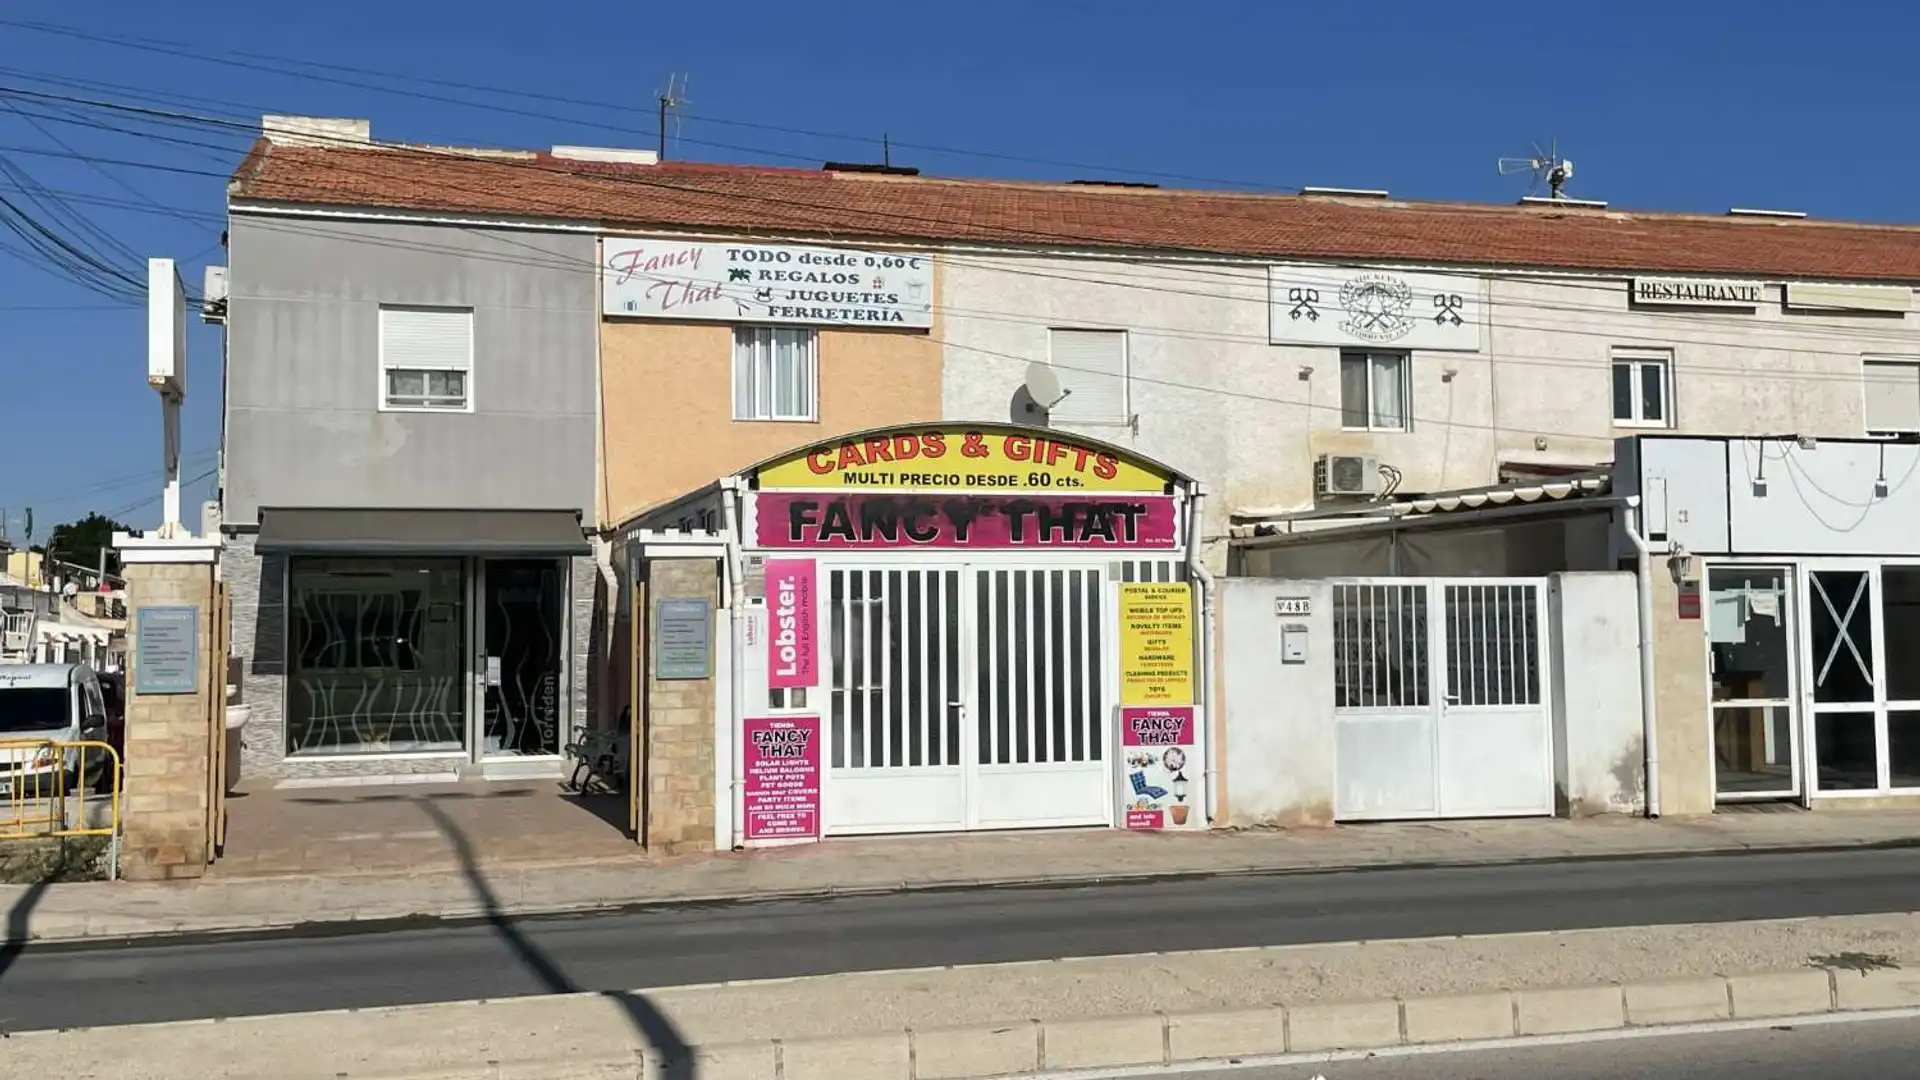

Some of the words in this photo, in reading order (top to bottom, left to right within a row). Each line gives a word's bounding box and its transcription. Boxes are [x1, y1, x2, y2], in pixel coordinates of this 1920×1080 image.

[727, 249, 791, 263] TODO
[799, 253, 857, 267] desde
[609, 248, 703, 285] Fancy
[758, 269, 860, 284] REGALOS
[645, 281, 725, 311] That
[785, 289, 899, 304] JUGUETES
[1640, 282, 1760, 301] RESTAURANTE
[768, 306, 904, 322] FERRETERIA
[806, 431, 947, 475] CARDS
[961, 431, 989, 458] &
[1003, 434, 1119, 480] GIFTS
[844, 472, 894, 484] MULTI
[900, 473, 960, 486] PRECIO
[966, 474, 1018, 487] DESDE
[1023, 472, 1051, 487] .60
[1056, 474, 1084, 487] cts.
[788, 499, 978, 544] FANCY
[1000, 500, 1148, 544] THAT
[800, 608, 811, 641] English
[1132, 718, 1184, 730] FANCY
[752, 730, 811, 743] FANCY
[1138, 731, 1179, 743] THAT
[759, 743, 806, 757] THAT
